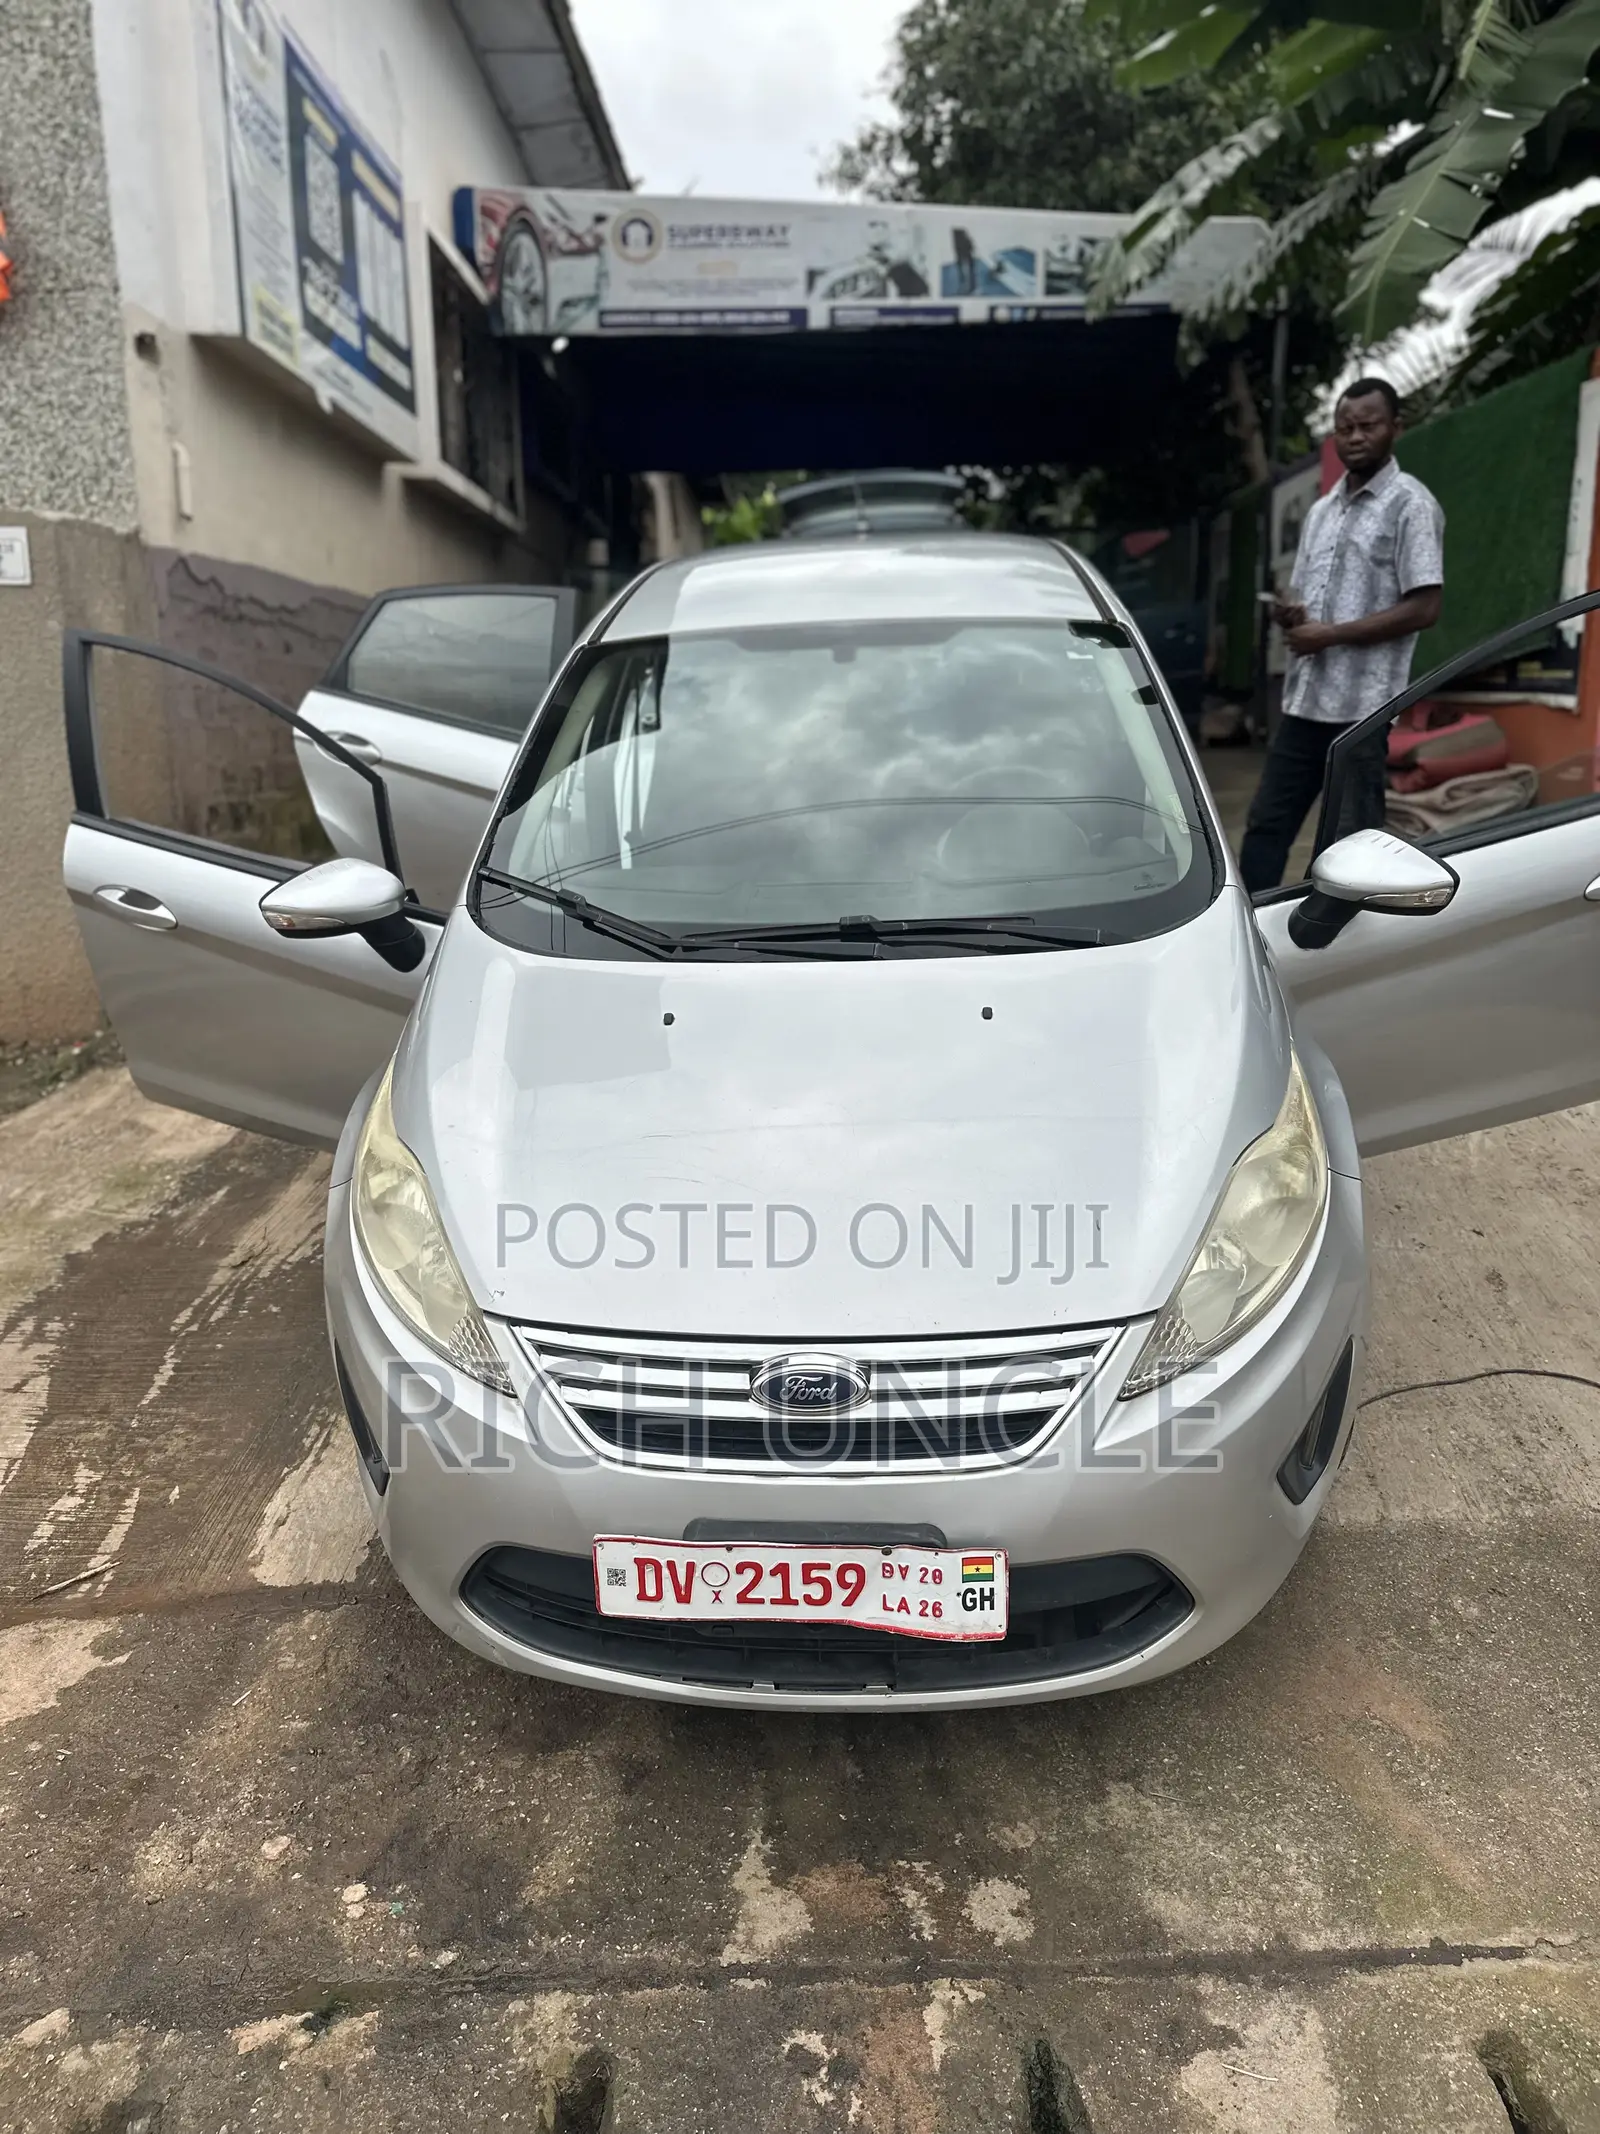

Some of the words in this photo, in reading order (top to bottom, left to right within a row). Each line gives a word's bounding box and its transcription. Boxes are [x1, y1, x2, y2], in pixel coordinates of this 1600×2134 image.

[780, 1376, 838, 1400] Ford
[634, 1557, 696, 1604] DV
[735, 1561, 866, 1606] 2159
[882, 1593, 911, 1615] LA
[918, 1599, 943, 1618] 26
[961, 1587, 995, 1612] GH
